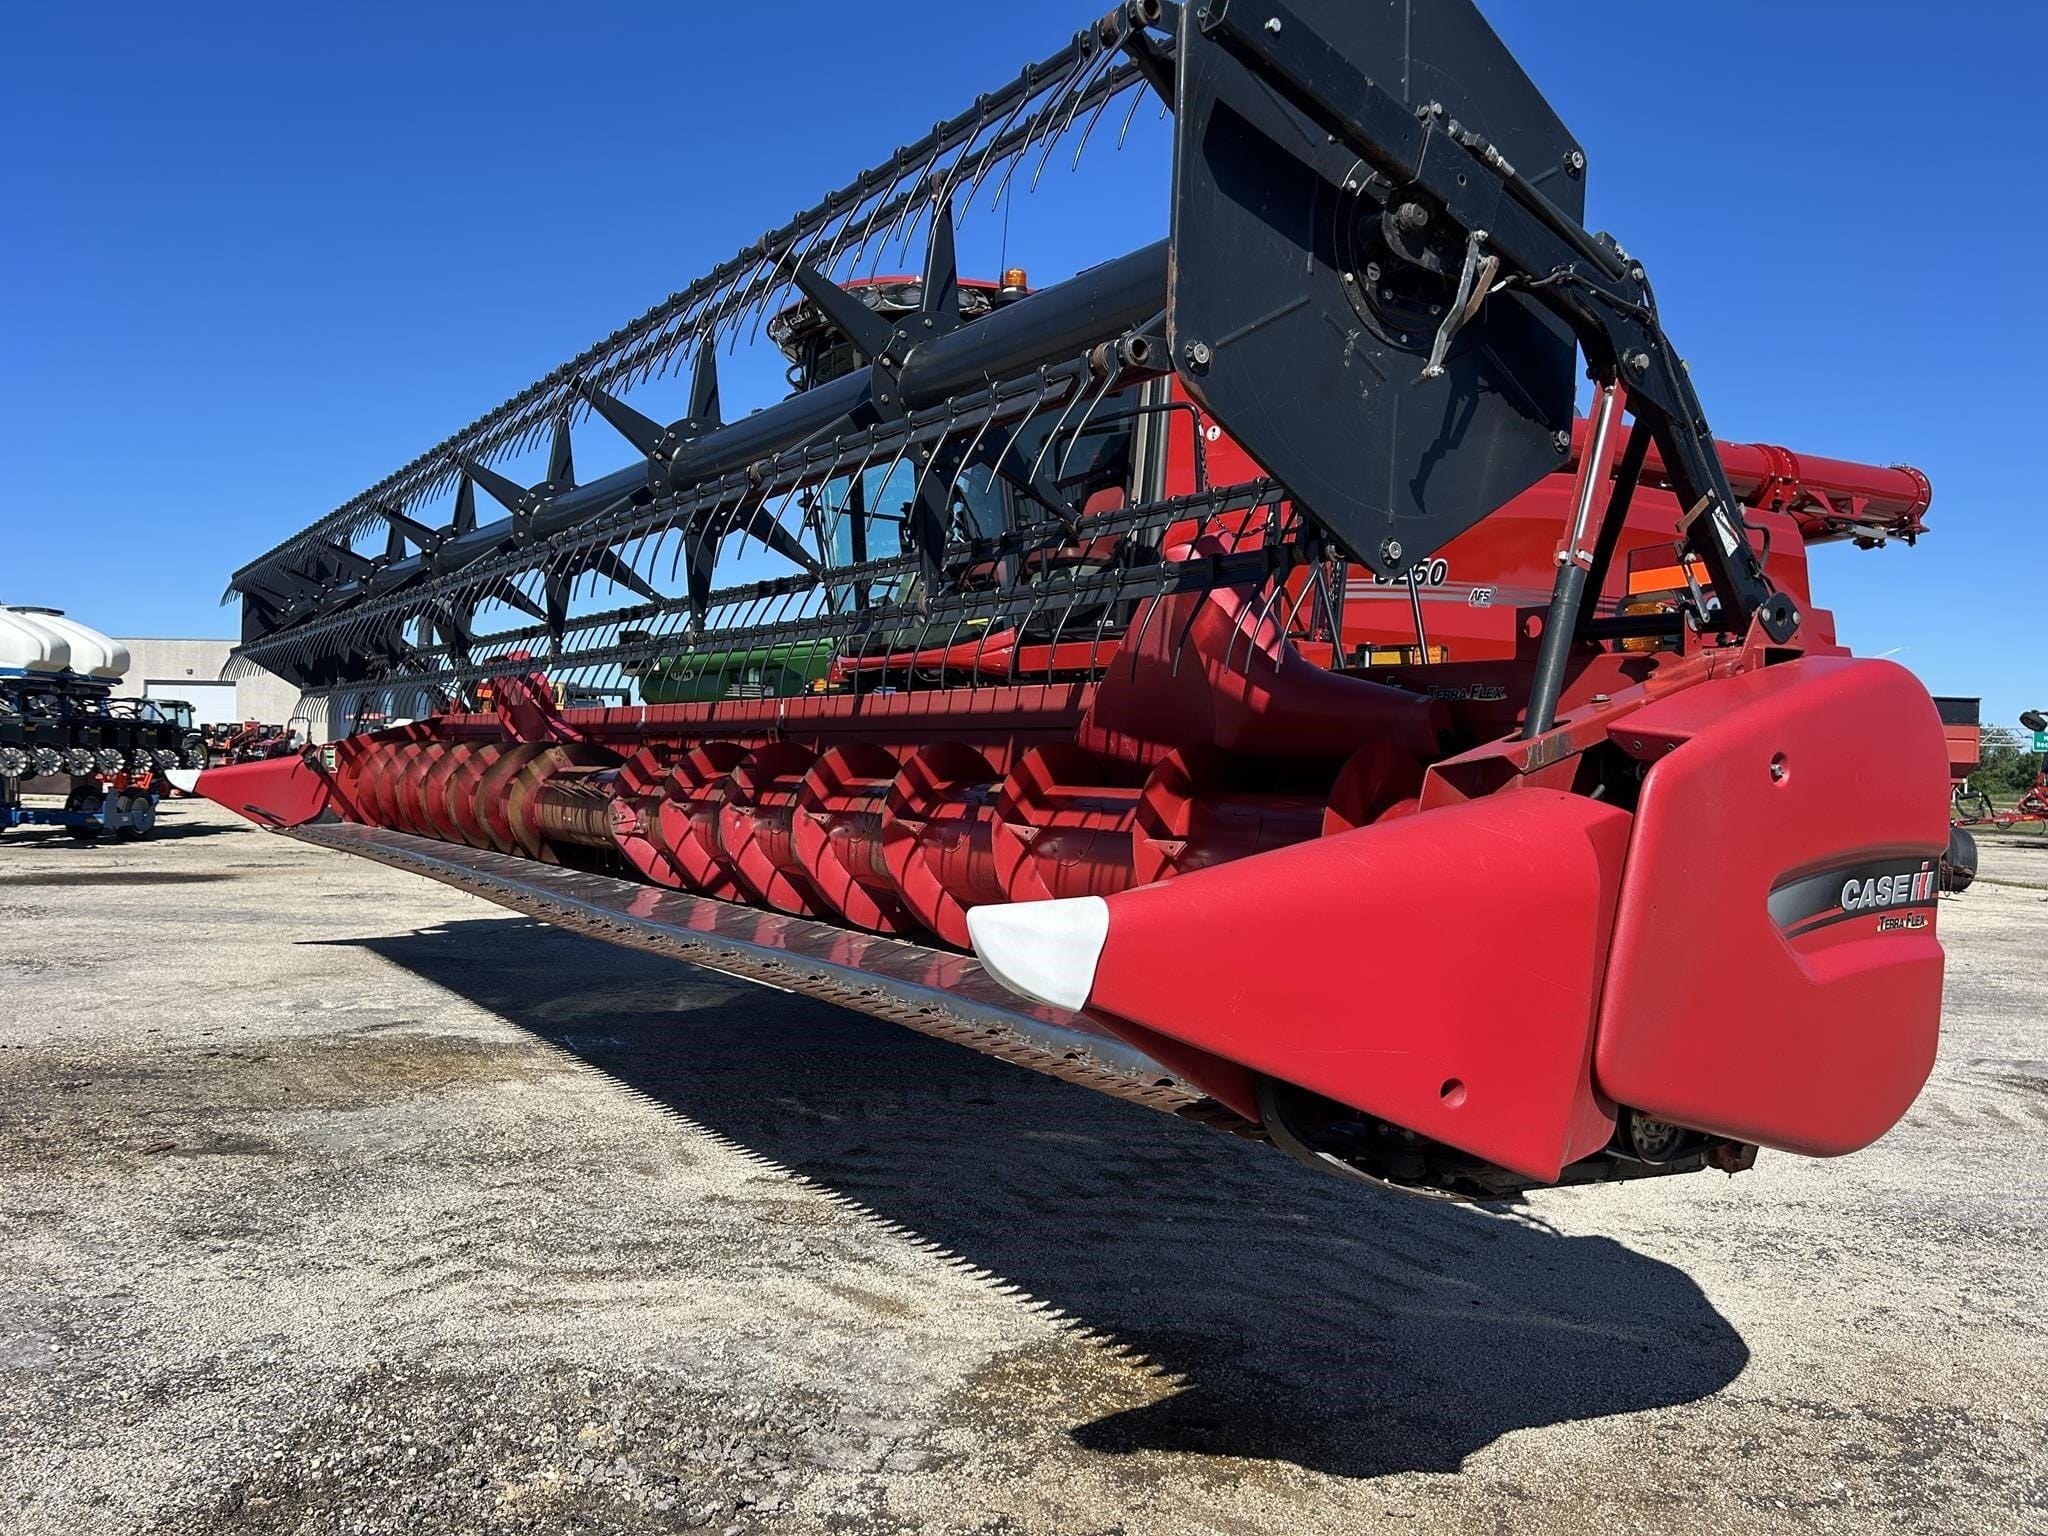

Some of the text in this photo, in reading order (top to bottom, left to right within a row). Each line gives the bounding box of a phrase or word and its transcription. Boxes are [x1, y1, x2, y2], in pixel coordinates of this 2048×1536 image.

[1468, 588, 1491, 602] AFS
[1469, 683, 1505, 699] FLEX
[1841, 873, 1911, 910] CASE
[1879, 912, 1926, 931] TERRA FLEX
